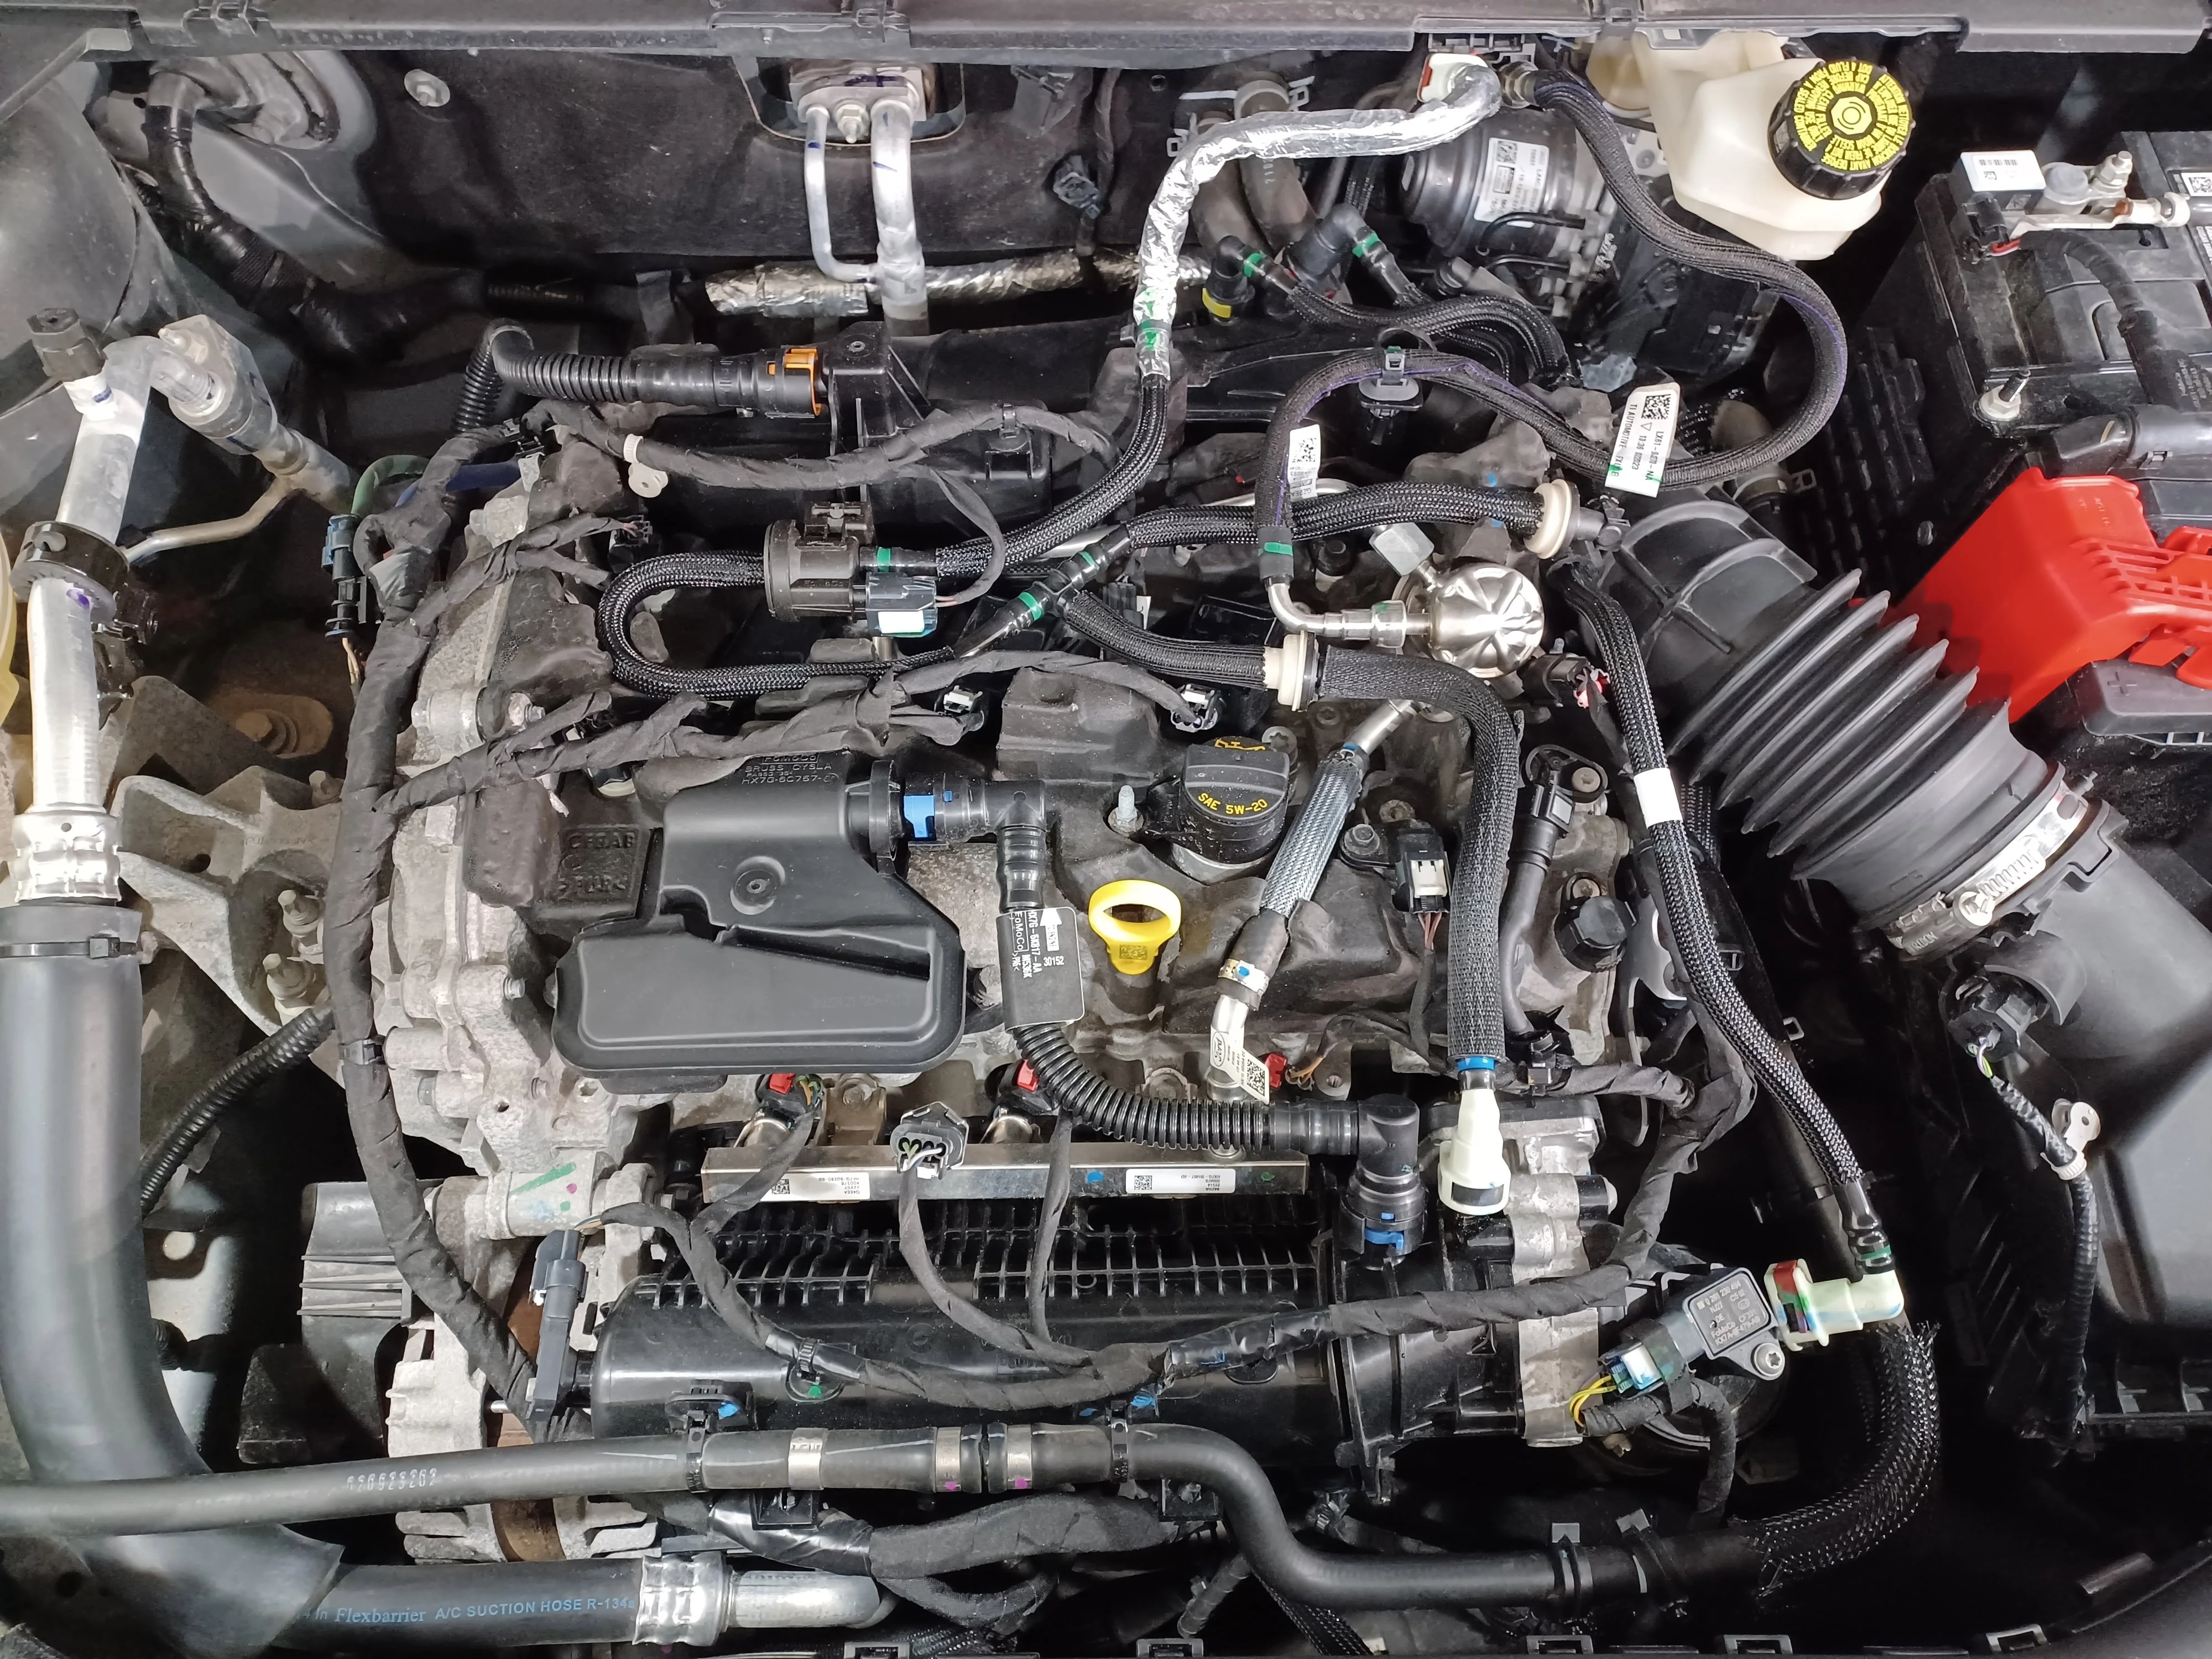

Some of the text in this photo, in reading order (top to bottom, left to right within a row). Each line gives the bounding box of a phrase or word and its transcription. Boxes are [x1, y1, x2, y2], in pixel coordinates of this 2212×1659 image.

[1809, 67, 1830, 85] FROM
[1827, 71, 1854, 82] BEFORE
[1829, 62, 1849, 74] FLUID
[1804, 81, 1813, 89] A
[1855, 73, 1870, 84] CAP
[1794, 87, 1810, 113] SEALED
[1805, 80, 1829, 109] REMOVING
[1804, 112, 1816, 124] USE
[1815, 82, 1866, 138] WARNING CLEAN FILLER
[1794, 115, 1817, 151] CONTAINER
[1850, 159, 1871, 170] AVANT
[1619, 411, 1635, 447] AUTOMOTIVE
[1198, 792, 1268, 815] SAE 5W-20
[1014, 912, 1024, 950] FoMoCo
[1044, 956, 1065, 966] 30152
[1720, 1287, 1731, 1297] 230
[334, 1607, 426, 1623] Flexbarrier
[435, 1607, 461, 1620] A/C
[467, 1602, 535, 1618] SUCTION
[540, 1599, 582, 1612] HOSE
[587, 1597, 635, 1610] R-134a
